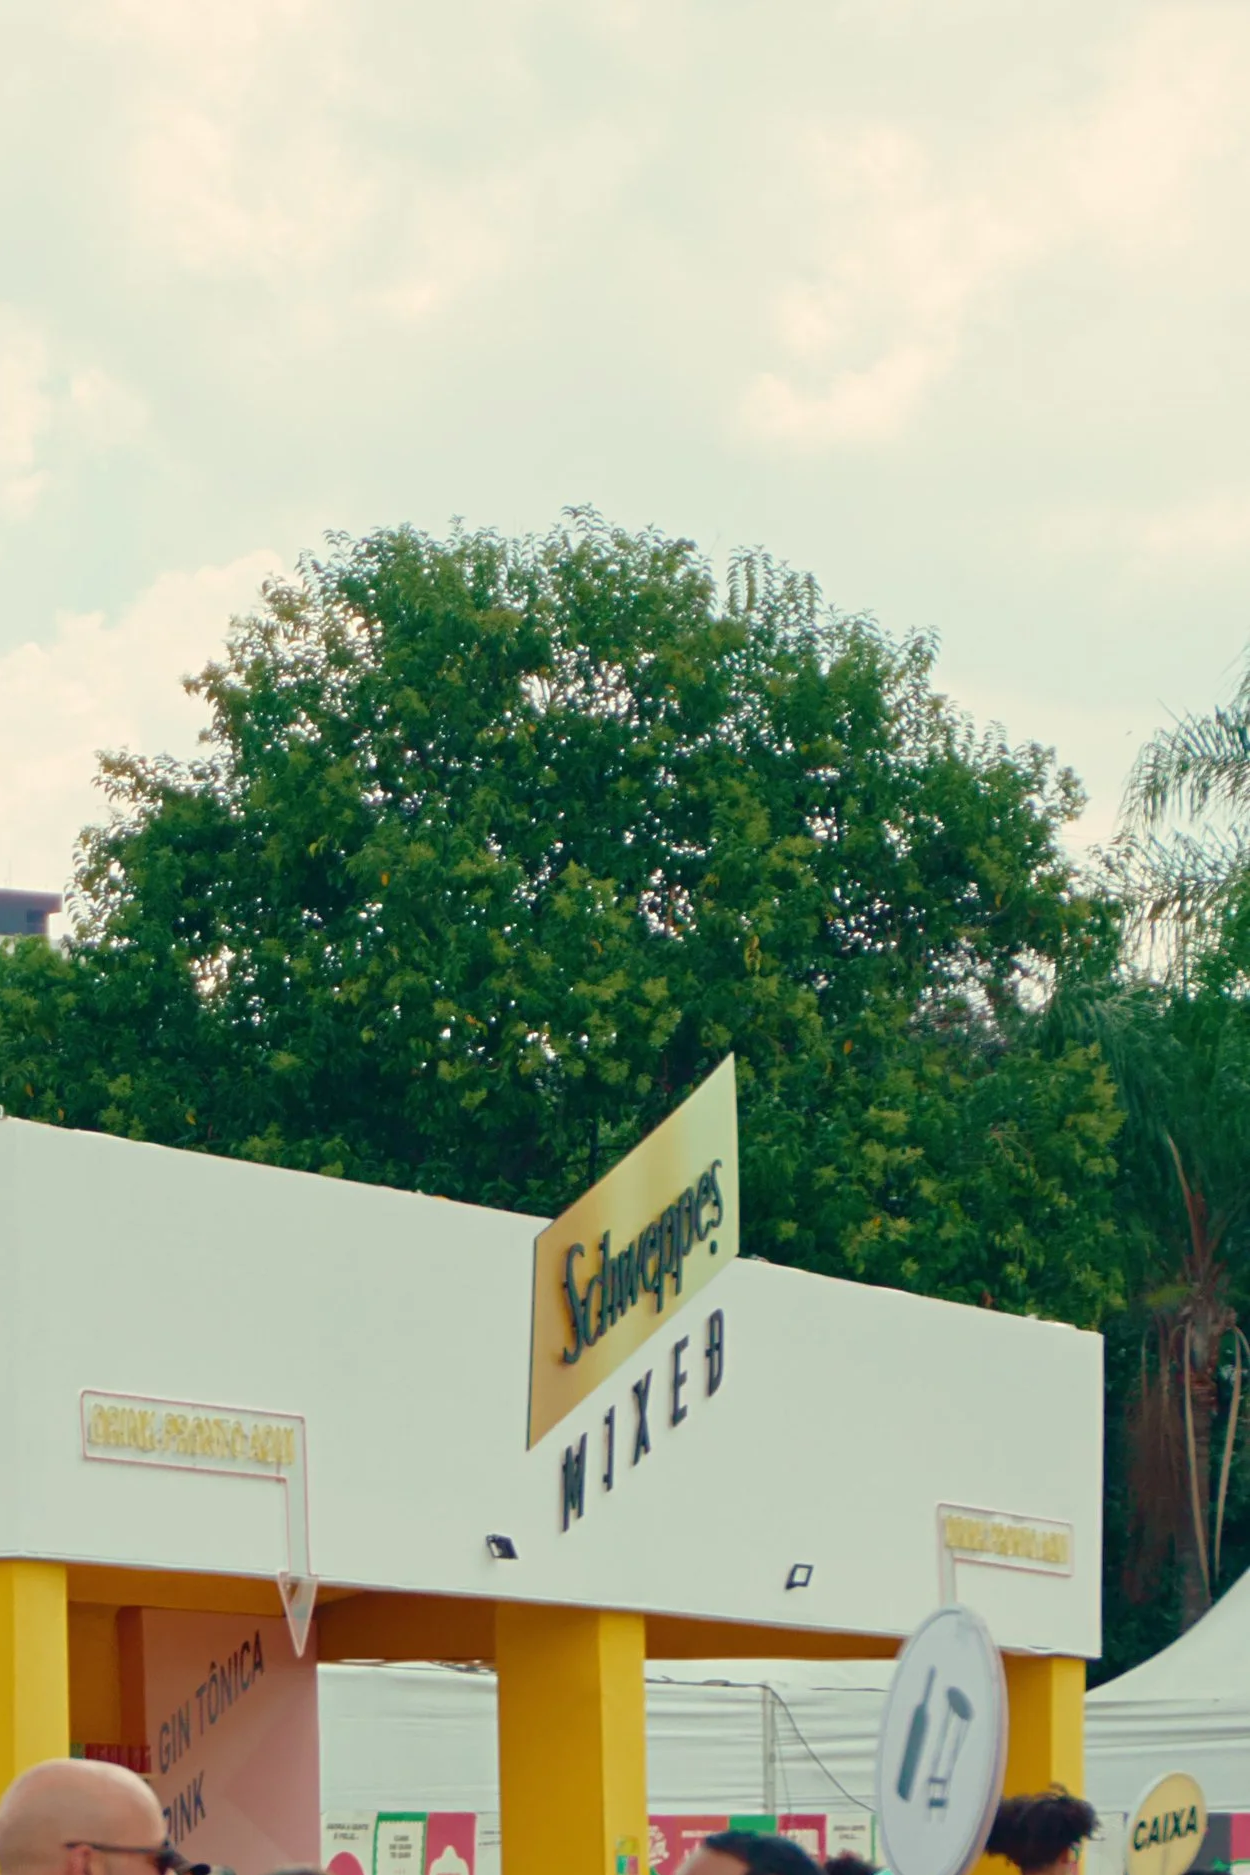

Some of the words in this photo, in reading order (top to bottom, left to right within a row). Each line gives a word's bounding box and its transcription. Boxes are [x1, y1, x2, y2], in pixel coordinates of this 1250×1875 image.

[562, 1158, 724, 1365] Schweppes
[561, 1307, 725, 1534] MIXED
[158, 1699, 191, 1775] GIN
[195, 1629, 265, 1736] TÔNICA
[1132, 1804, 1199, 1852] CAIXA
